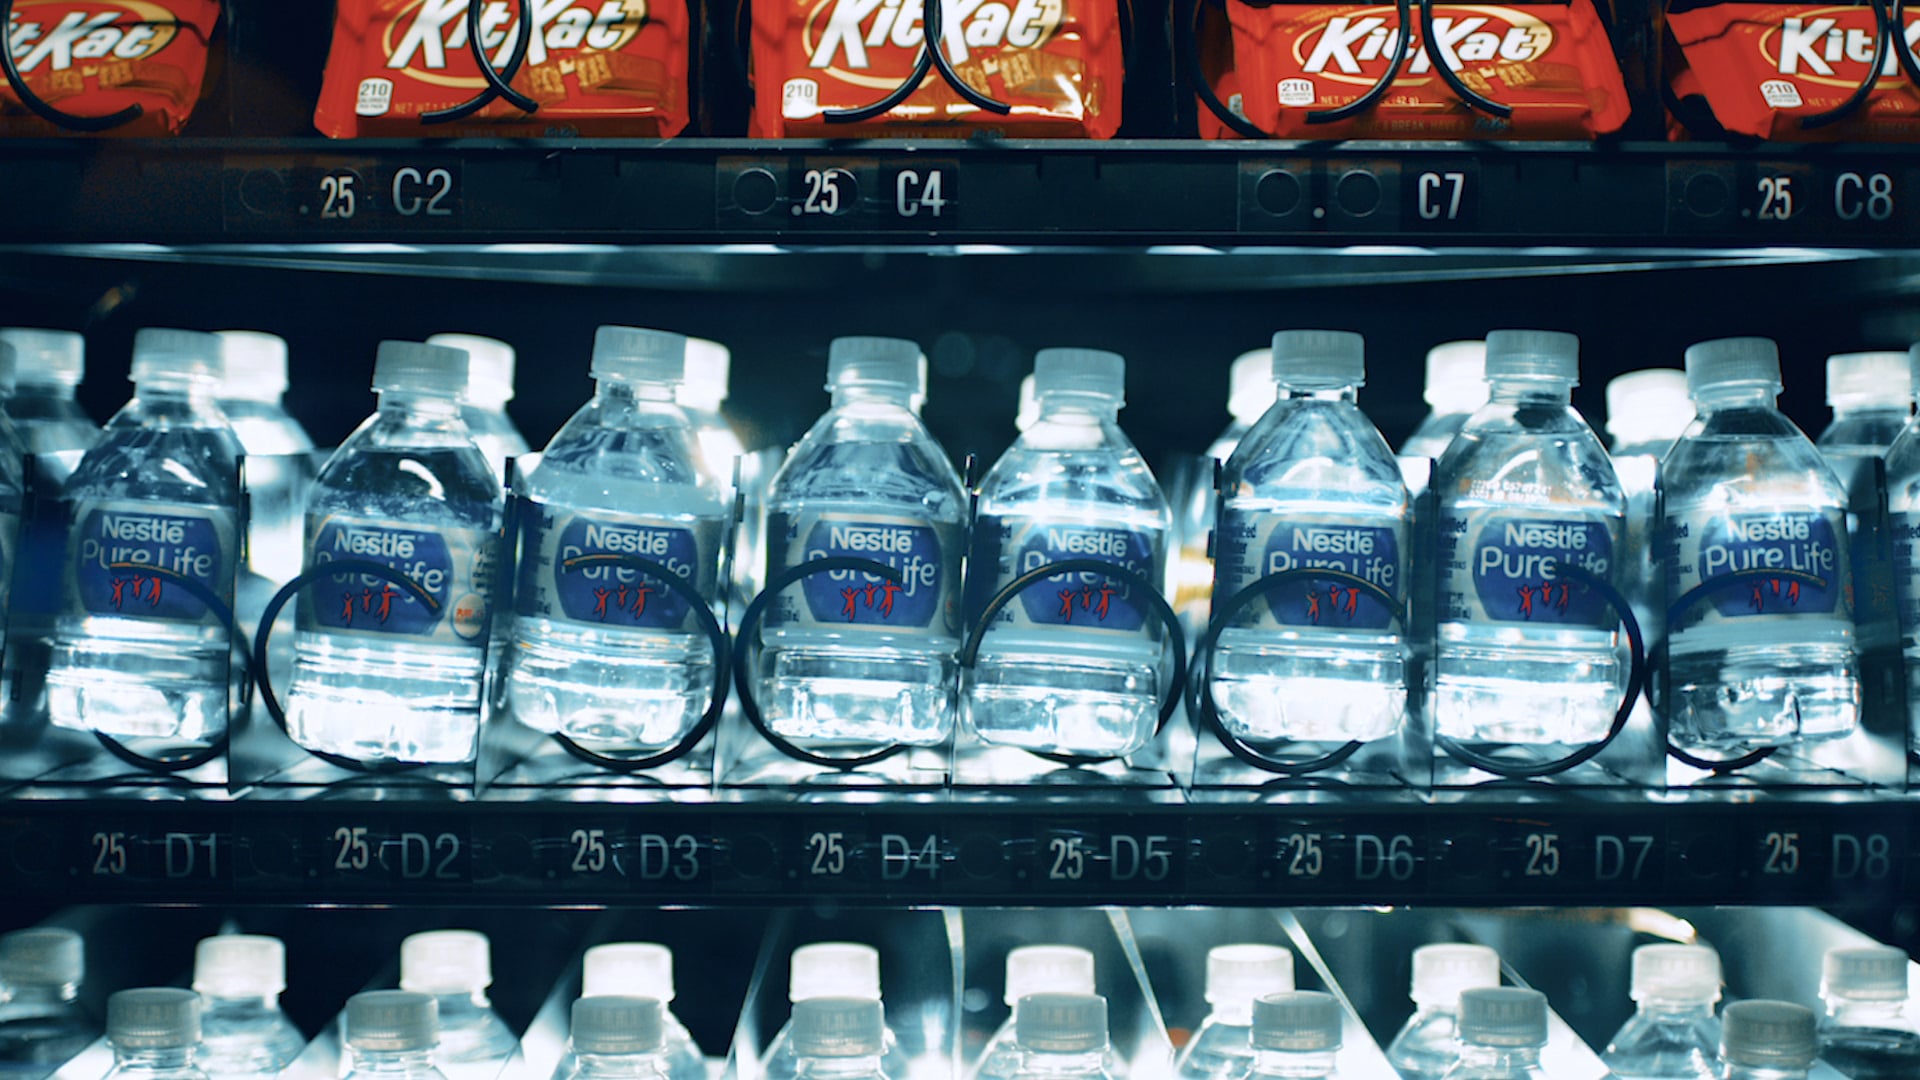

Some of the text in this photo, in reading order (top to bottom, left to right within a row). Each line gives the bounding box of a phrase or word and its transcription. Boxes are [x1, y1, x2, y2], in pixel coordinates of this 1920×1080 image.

[10, 12, 155, 72] tKat
[1778, 17, 1920, 76] KitK
[360, 83, 388, 97] 210
[786, 84, 814, 98] 210
[1281, 82, 1310, 92] 210
[1764, 83, 1794, 95] 210
[392, 168, 453, 216] C2
[896, 170, 946, 218] C4
[1418, 173, 1465, 220] C7
[1834, 173, 1894, 221] C8
[1480, 546, 1557, 580] Pure
[1706, 545, 1785, 575] Pure
[1790, 542, 1834, 576] Life
[165, 832, 218, 878] D1
[402, 832, 461, 879] D2
[640, 834, 699, 880] D3
[881, 834, 941, 880] D4
[1110, 835, 1170, 880] D5
[1355, 835, 1415, 880] D6
[1595, 835, 1655, 880] D7
[1832, 834, 1890, 880] D8
